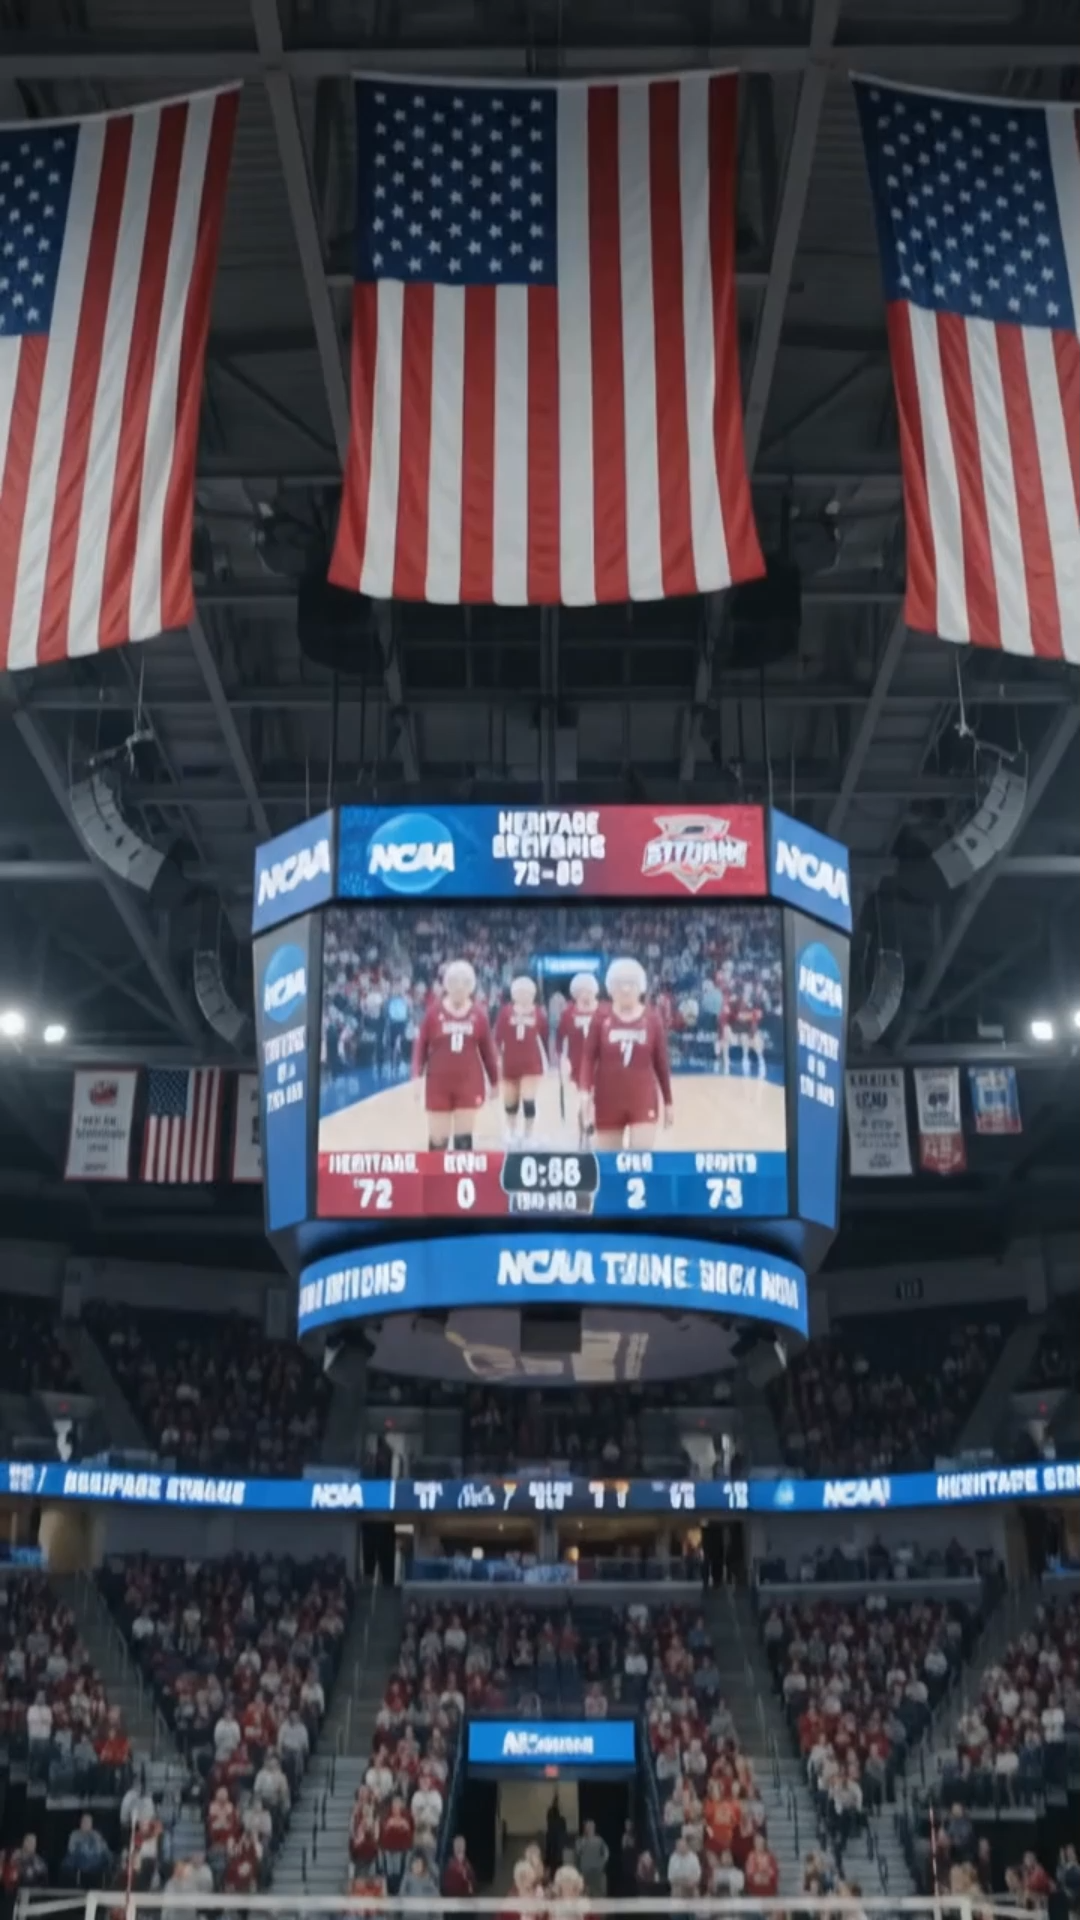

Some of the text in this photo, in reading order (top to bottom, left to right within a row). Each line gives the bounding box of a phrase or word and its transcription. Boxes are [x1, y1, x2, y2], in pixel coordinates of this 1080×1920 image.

[257, 839, 330, 906] NCAA
[368, 841, 455, 874] NCAA
[776, 839, 850, 906] NCAA
[359, 1177, 393, 1209] 72
[456, 1177, 476, 1209] 0
[626, 1177, 646, 1210] 2
[705, 1177, 743, 1210] 73
[497, 1249, 595, 1285] NCAA
